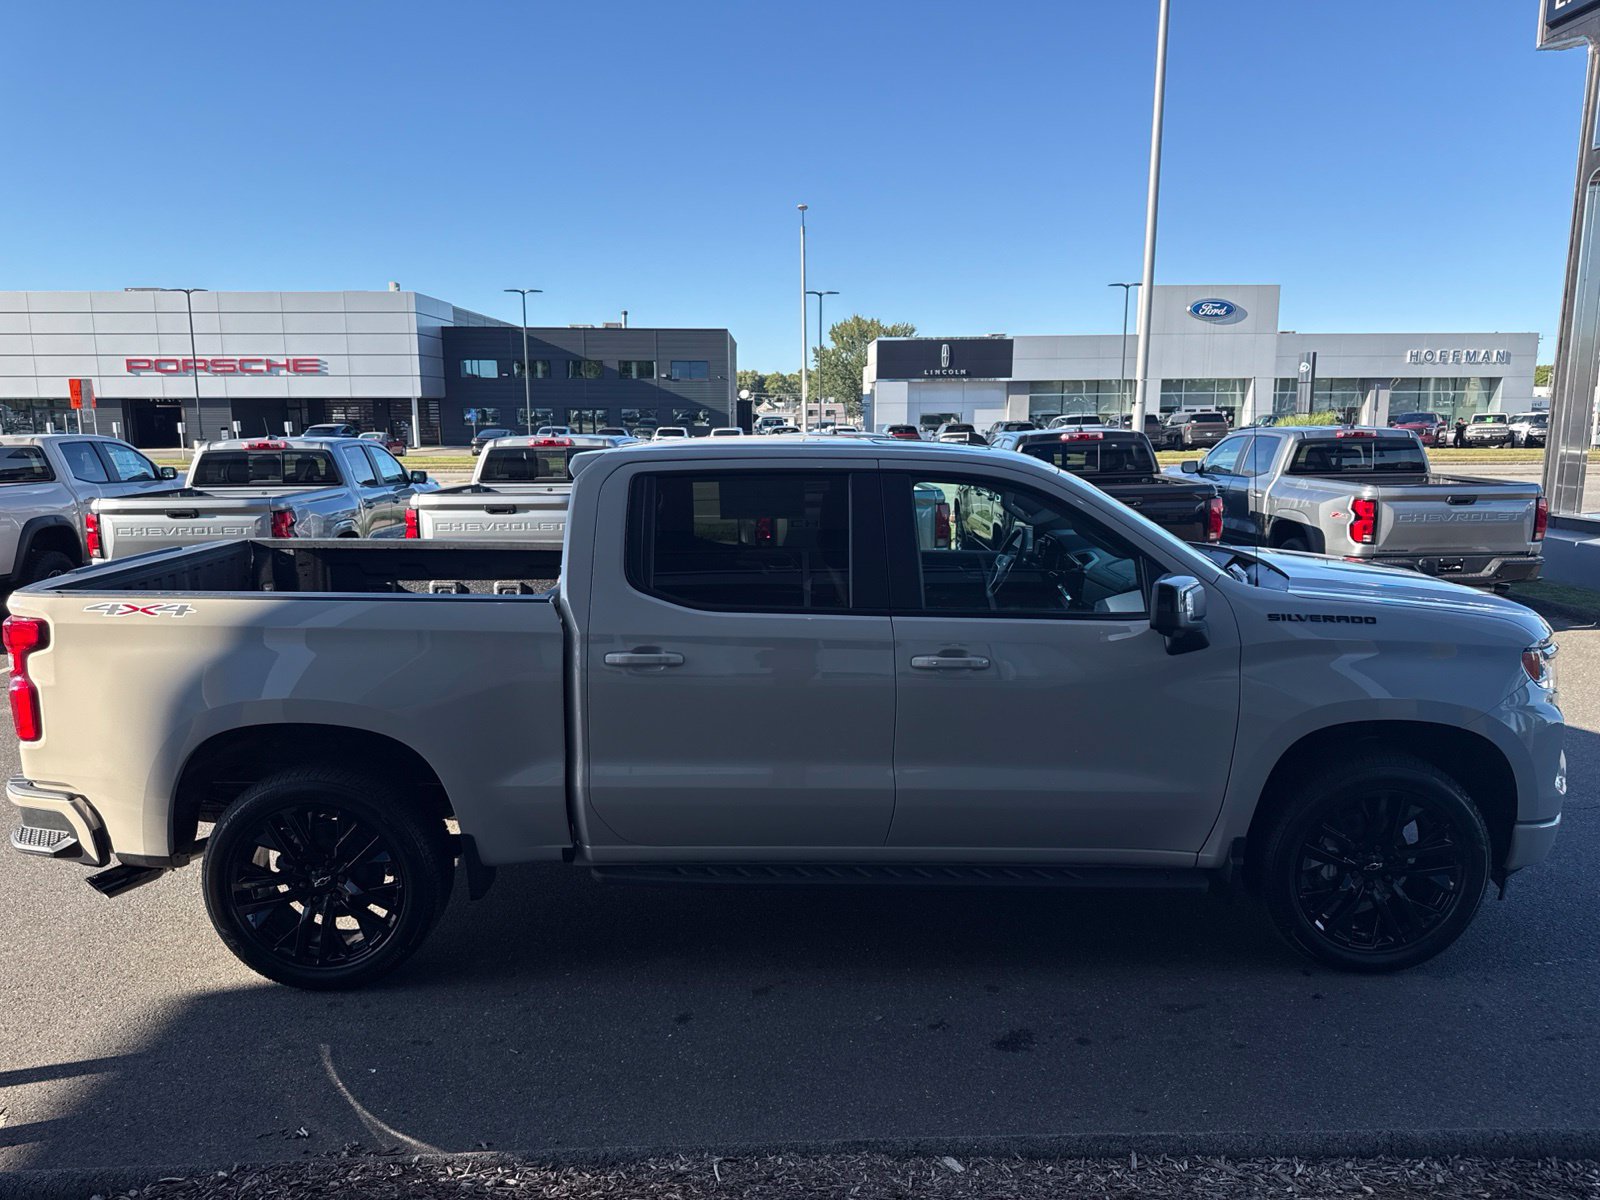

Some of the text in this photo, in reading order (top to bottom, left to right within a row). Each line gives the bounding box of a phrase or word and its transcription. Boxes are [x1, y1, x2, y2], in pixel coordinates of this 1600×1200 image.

[1198, 303, 1227, 315] Ford
[1408, 350, 1507, 363] HOFFMAN
[125, 358, 321, 373] PORSCHE
[1399, 512, 1524, 523] CHEVROLET
[116, 526, 252, 537] CHEVROLET
[435, 522, 567, 532] CHEVROLET
[1266, 613, 1377, 625] SILVERADO
